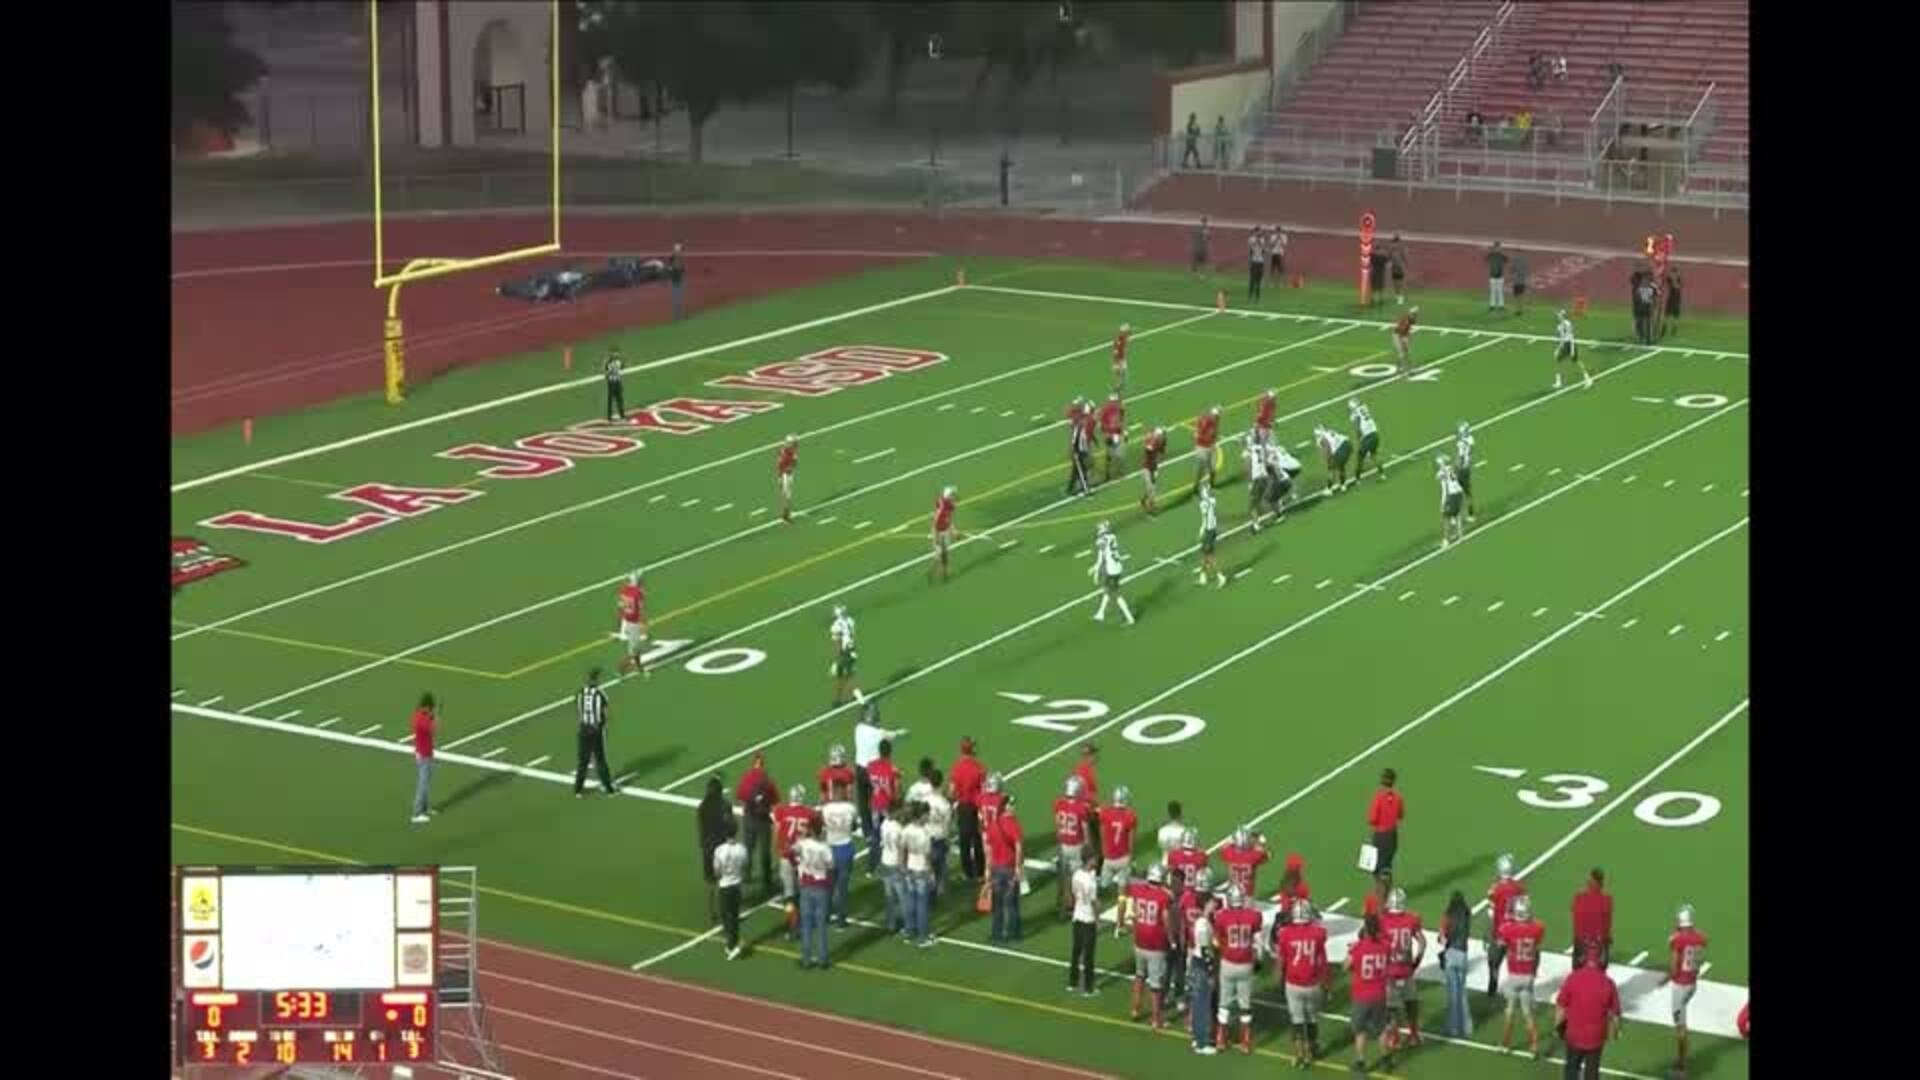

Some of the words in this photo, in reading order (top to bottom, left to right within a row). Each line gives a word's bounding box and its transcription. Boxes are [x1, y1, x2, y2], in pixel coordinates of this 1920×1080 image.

[200, 484, 486, 543] LA
[435, 397, 785, 478] JOYA
[706, 345, 950, 396] ISD
[1010, 697, 1207, 746] 20
[1516, 773, 1722, 827] 30
[1111, 821, 1124, 844] 7
[1290, 939, 1317, 965] 74
[1361, 953, 1387, 980] 64
[208, 1005, 221, 1027] 0
[276, 991, 327, 1018] 5:33
[413, 1004, 427, 1027] 0
[236, 1041, 251, 1065] 2
[276, 1042, 297, 1064] 10
[333, 1041, 353, 1062] 14
